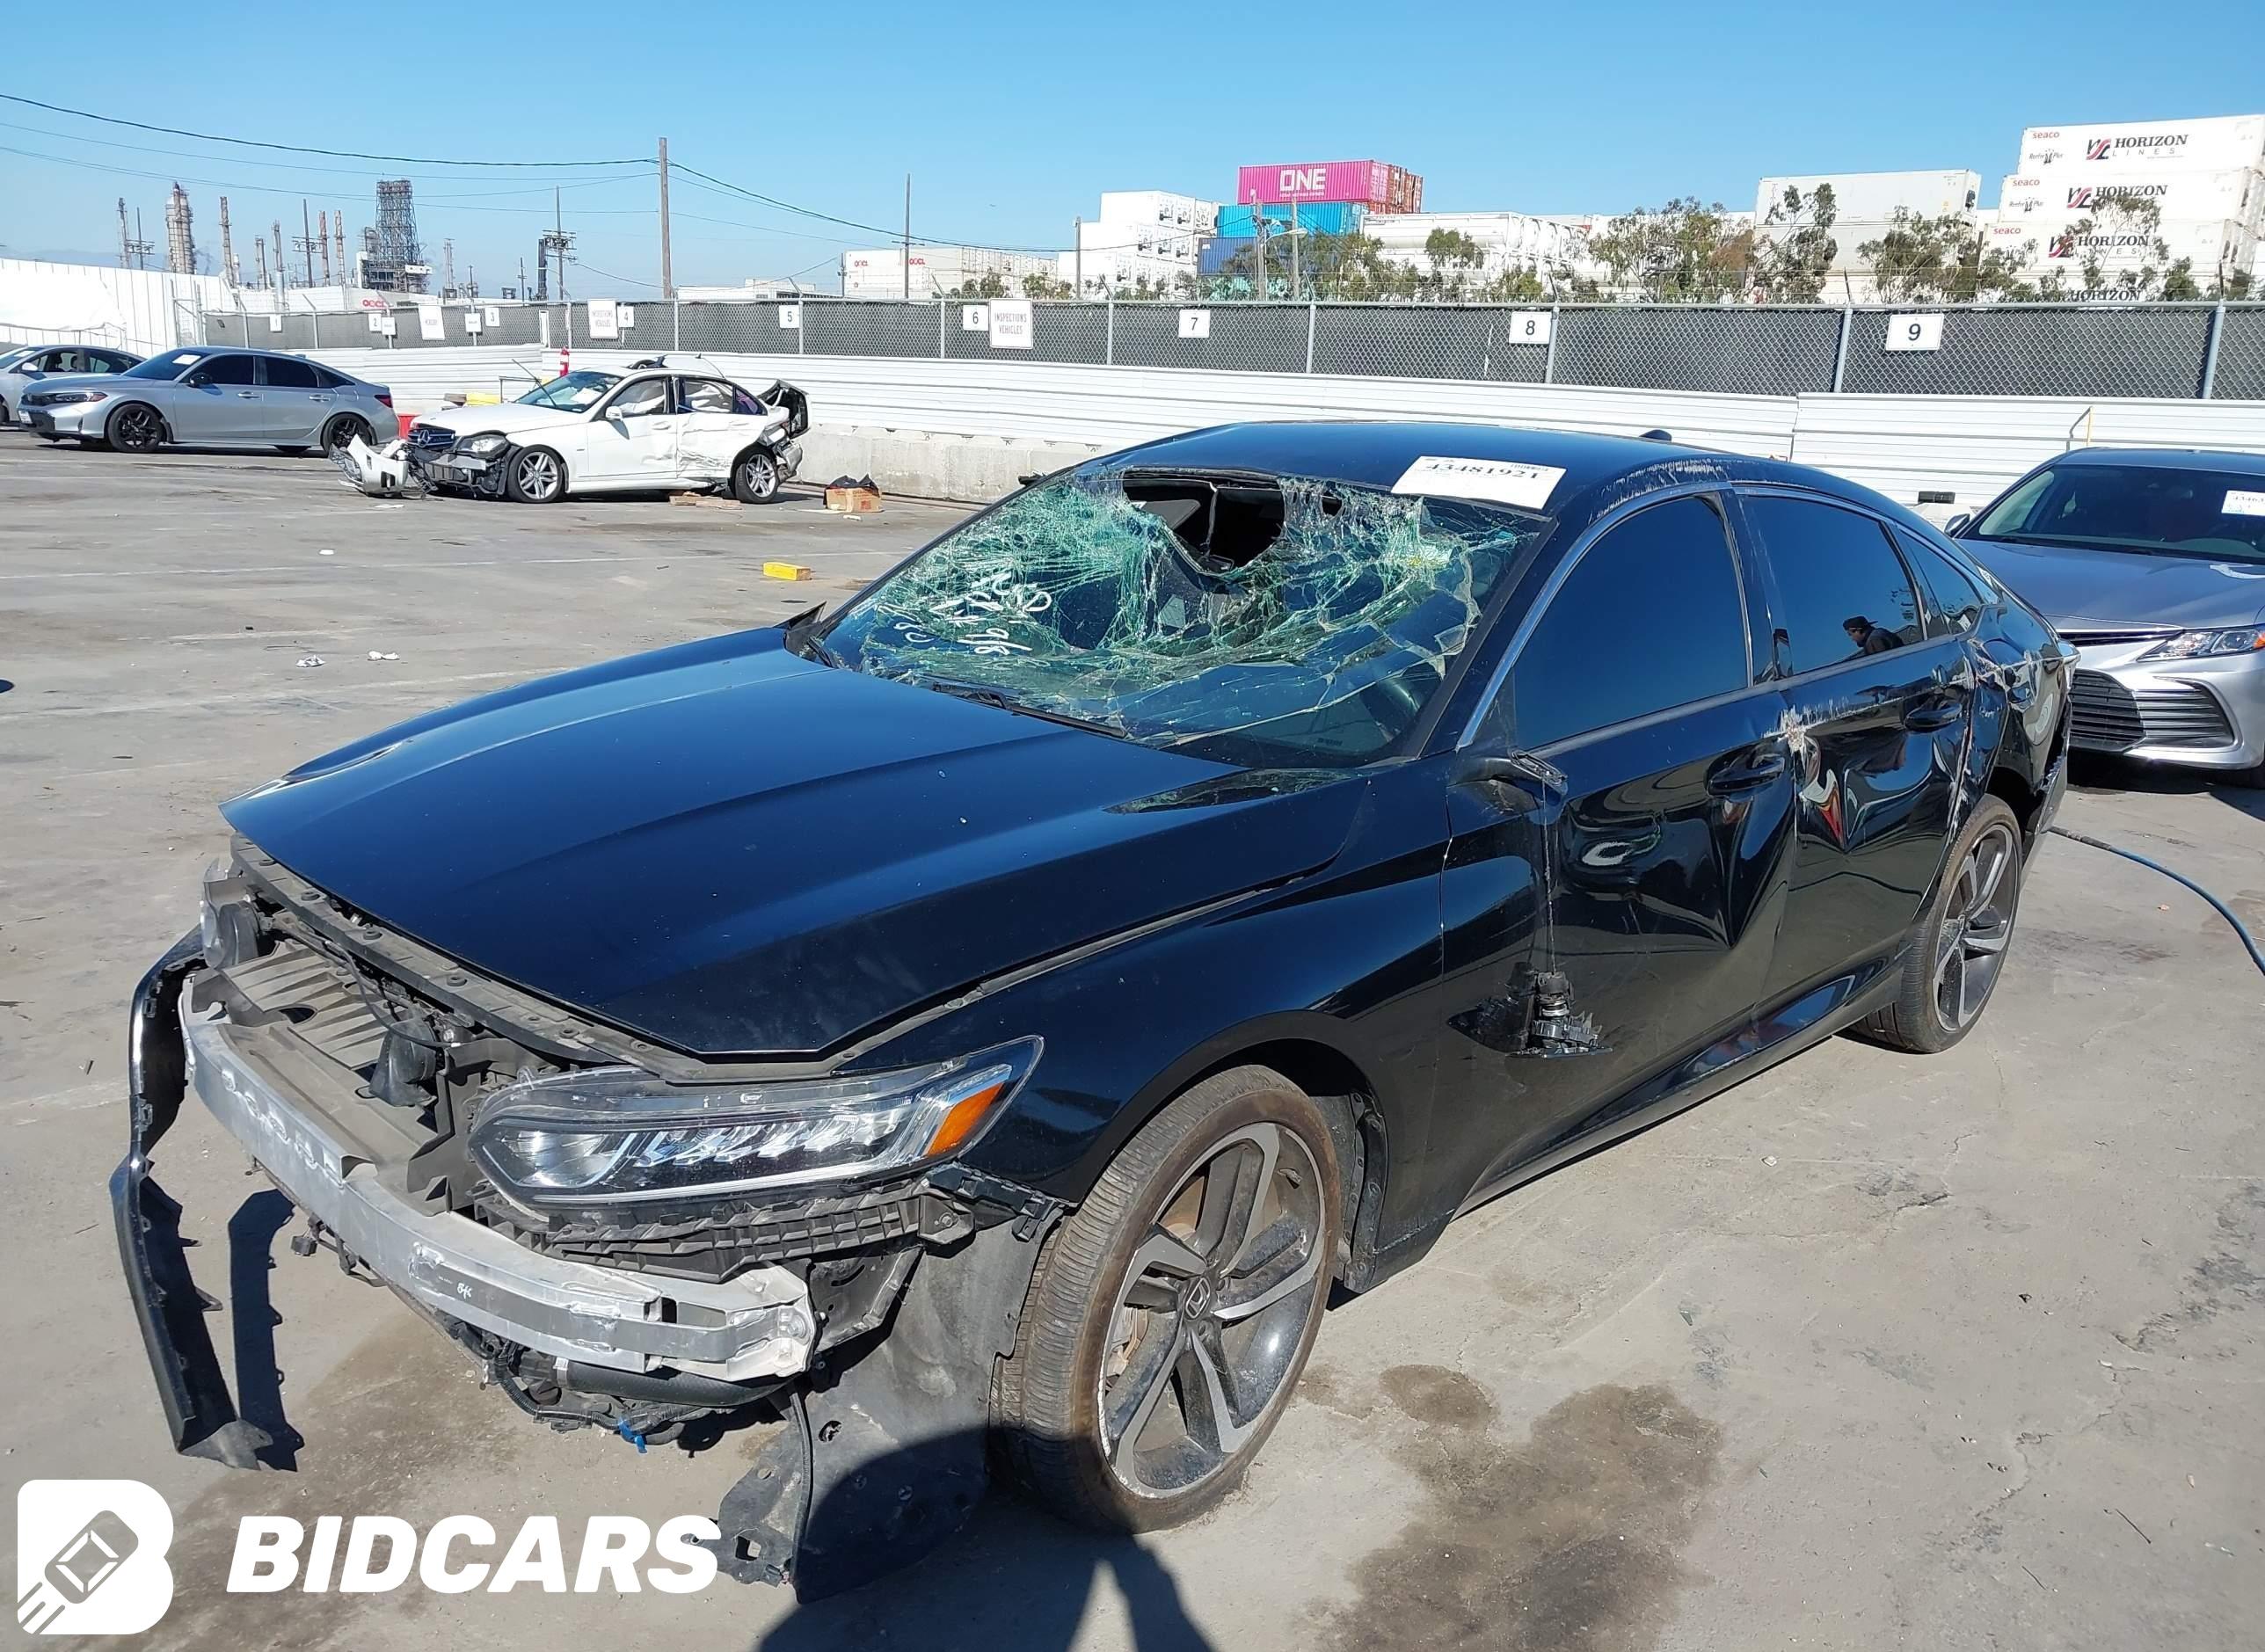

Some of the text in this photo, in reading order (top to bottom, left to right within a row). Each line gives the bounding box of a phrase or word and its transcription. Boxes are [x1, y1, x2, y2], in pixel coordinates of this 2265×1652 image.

[2114, 135, 2189, 149] HORIZON
[1279, 168, 1326, 192] ONE
[2095, 185, 2168, 198] HORIZON
[2078, 235, 2150, 246] HORIZON
[787, 310, 793, 322] 5
[972, 311, 979, 324] 6
[1191, 317, 1198, 331] 7
[1526, 320, 1535, 336] 8
[1907, 323, 1921, 341] 9
